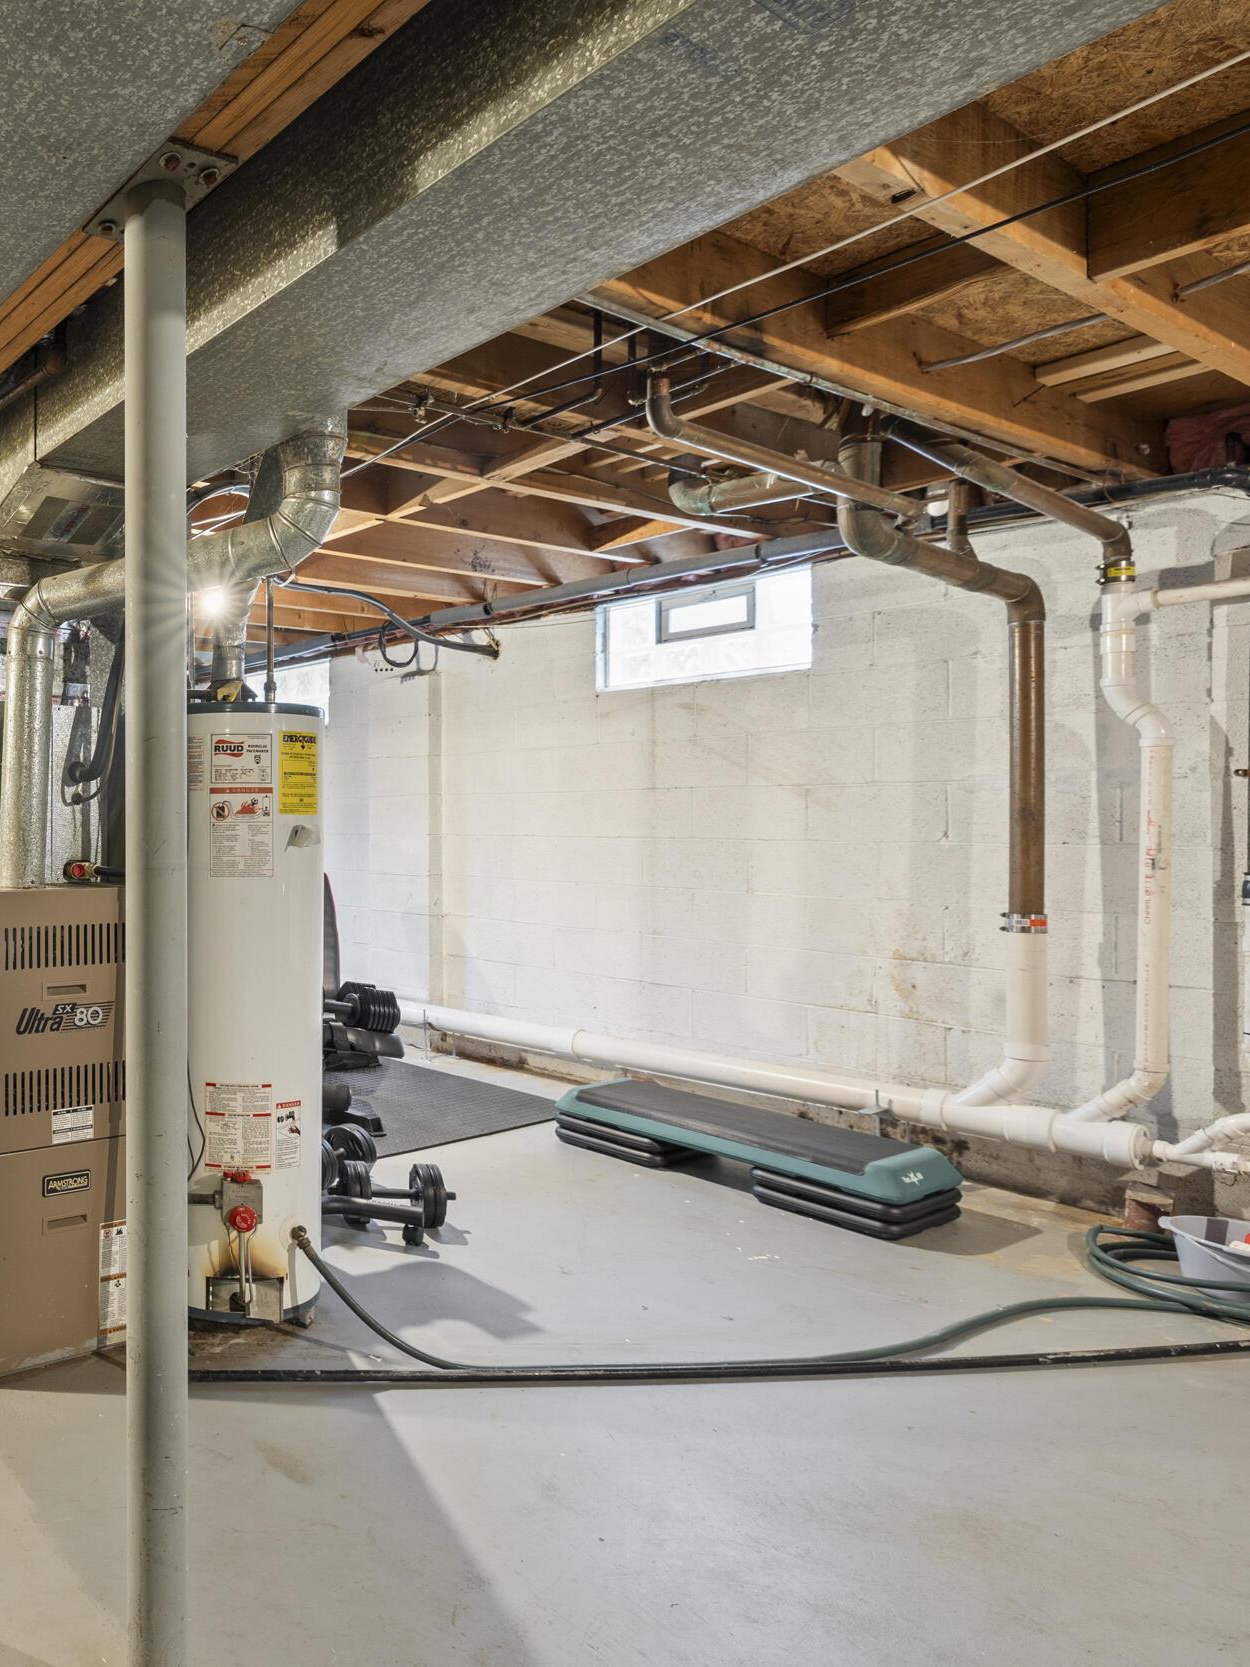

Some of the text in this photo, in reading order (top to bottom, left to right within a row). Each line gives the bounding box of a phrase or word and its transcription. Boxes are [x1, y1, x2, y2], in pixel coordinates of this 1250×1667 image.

[55, 1005, 73, 1014] SX
[15, 1006, 103, 1035] Ultra 80
[48, 1176, 88, 1190] ARMSTRONG
